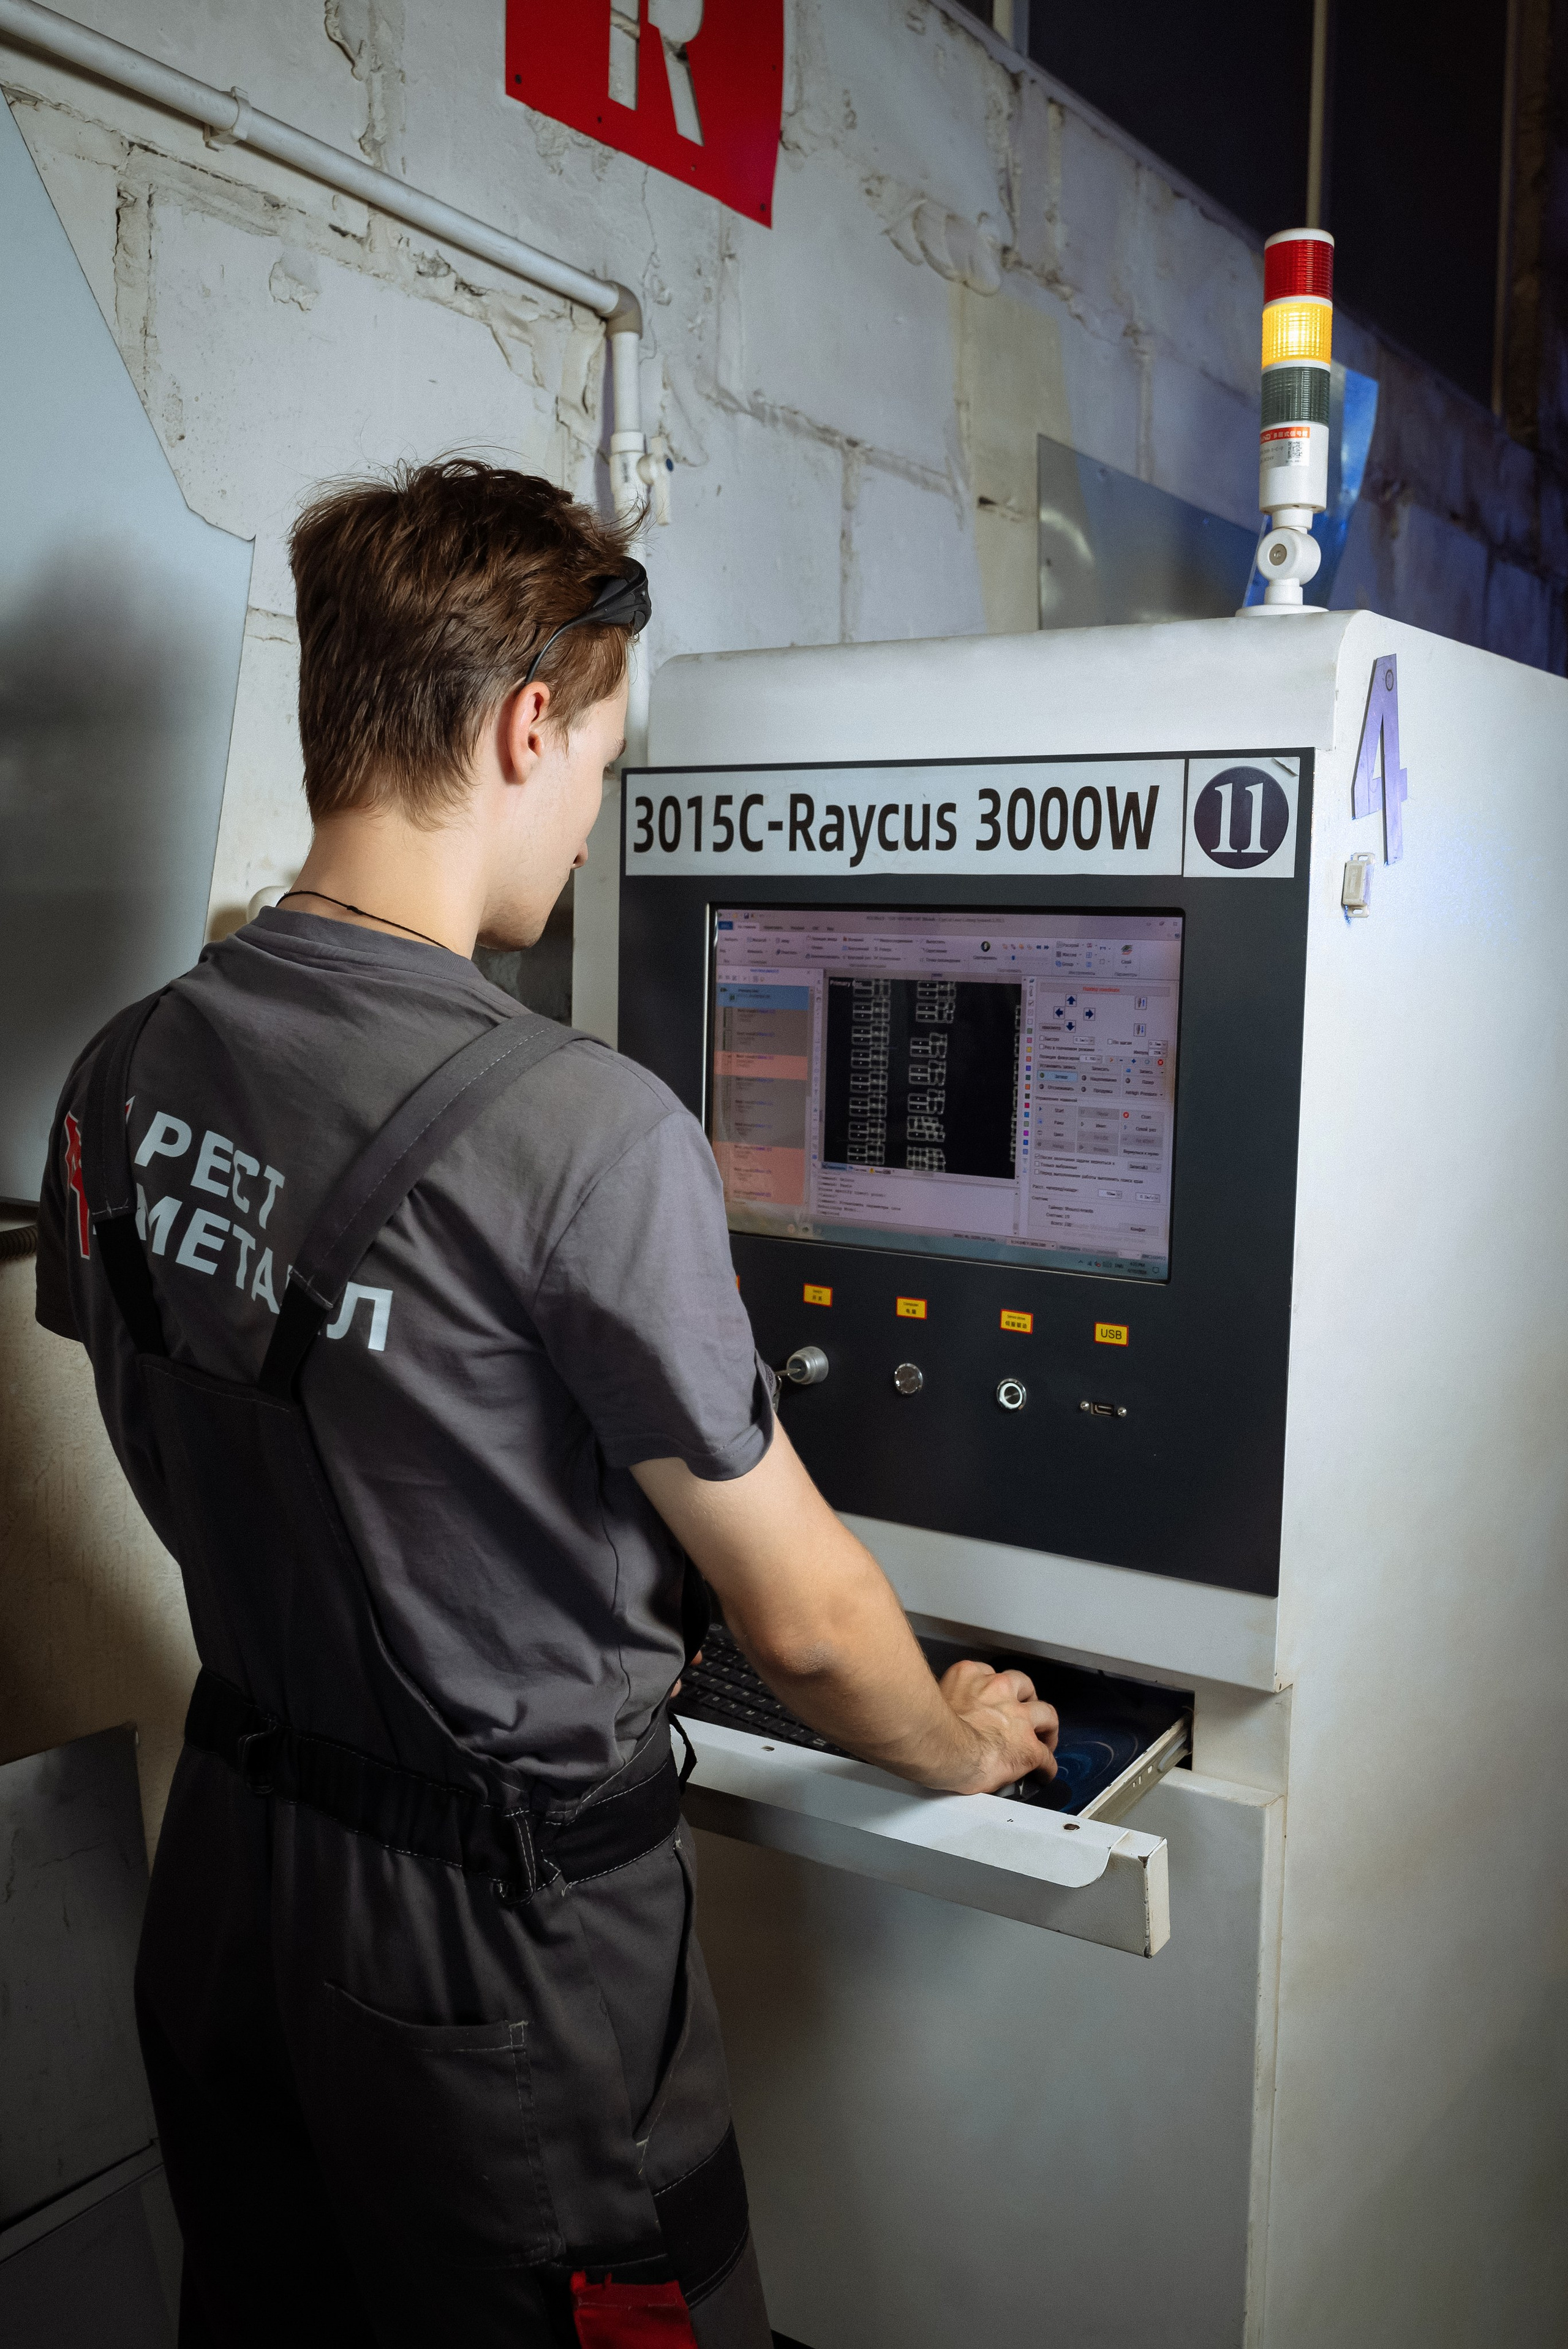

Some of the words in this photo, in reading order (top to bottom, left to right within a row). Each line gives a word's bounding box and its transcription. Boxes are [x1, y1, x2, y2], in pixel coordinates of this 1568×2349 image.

[633, 792, 957, 868] 3015C-Raycus
[975, 785, 1159, 851] 3000W
[1211, 782, 1269, 854] 11
[1101, 1328, 1122, 1340] USB
